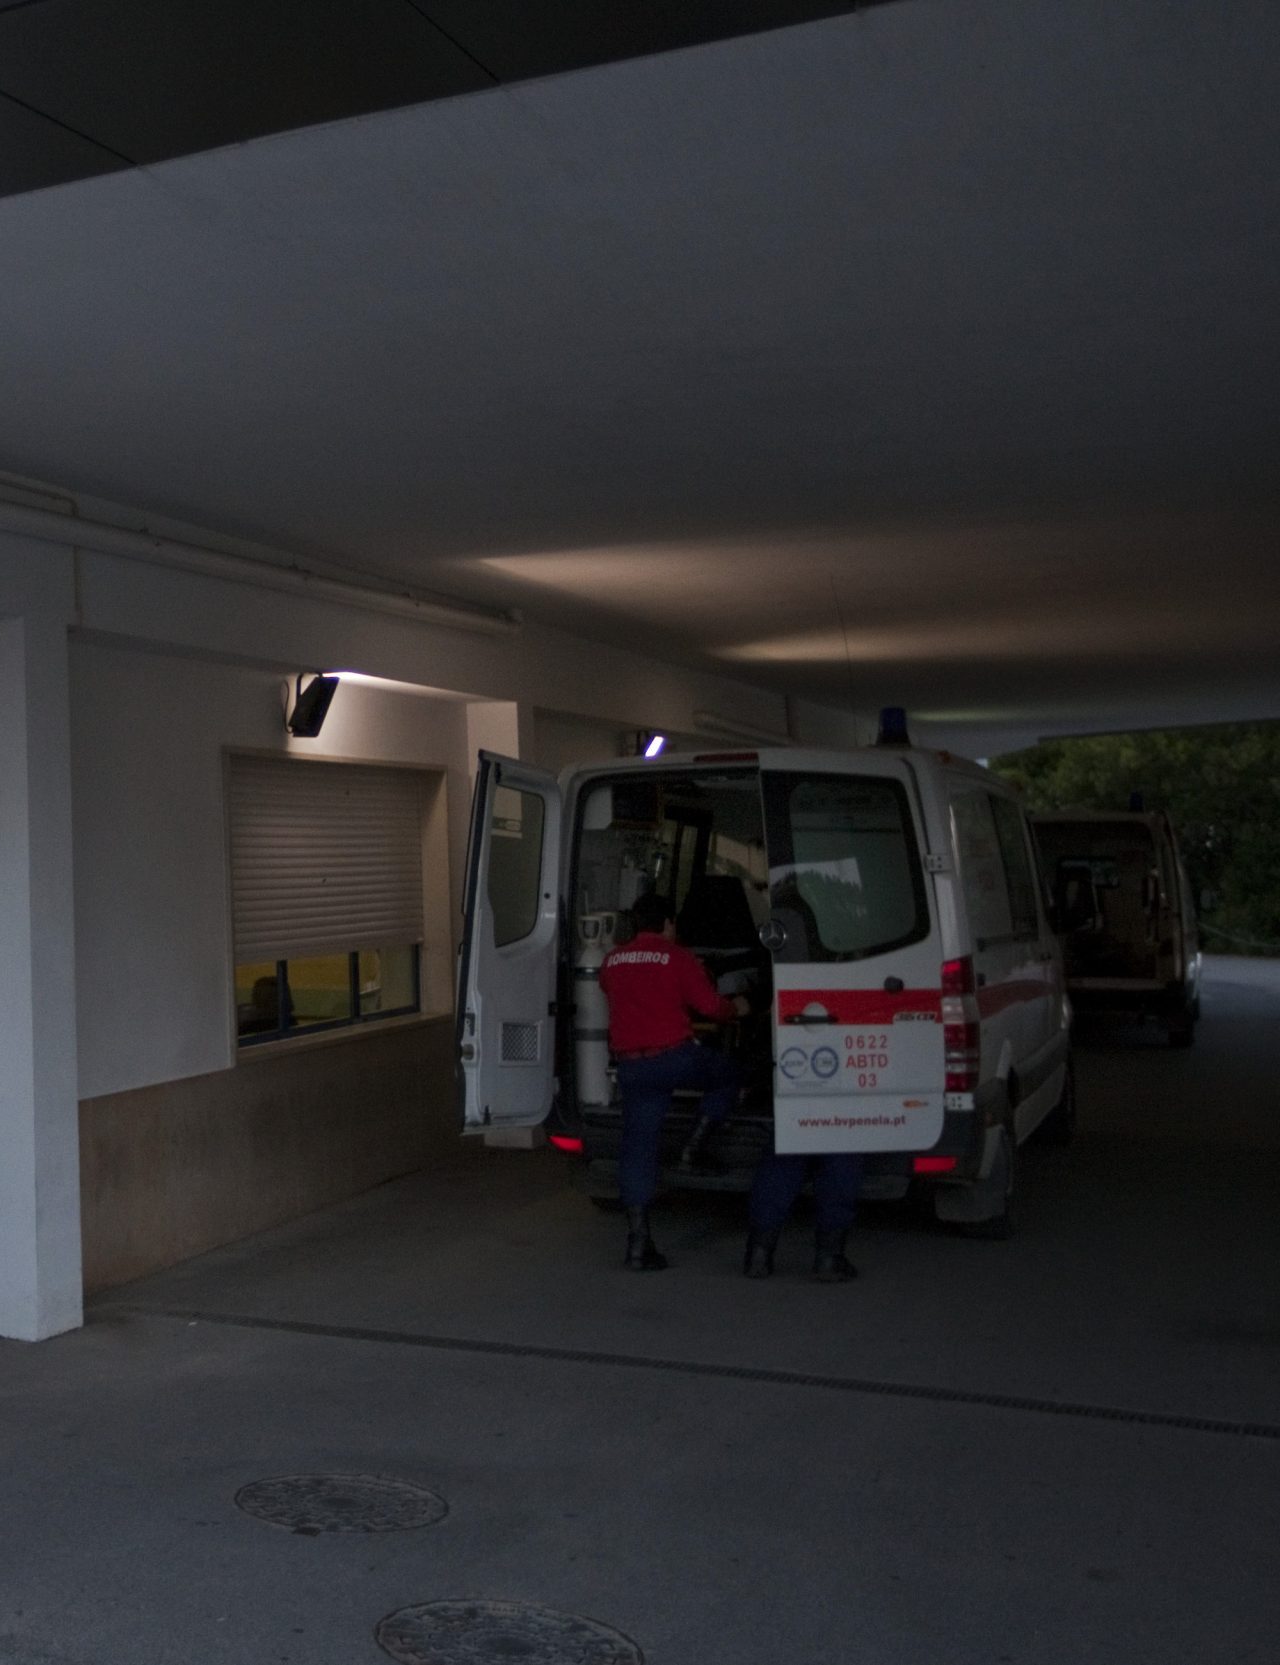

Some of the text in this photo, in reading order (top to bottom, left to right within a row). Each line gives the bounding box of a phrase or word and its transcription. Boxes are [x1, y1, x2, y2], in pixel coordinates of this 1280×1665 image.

[845, 1034, 888, 1049] 0622
[846, 1053, 888, 1069] ABTD
[858, 1073, 877, 1088] 03
[798, 1114, 906, 1129] www.bvpenela.pt
